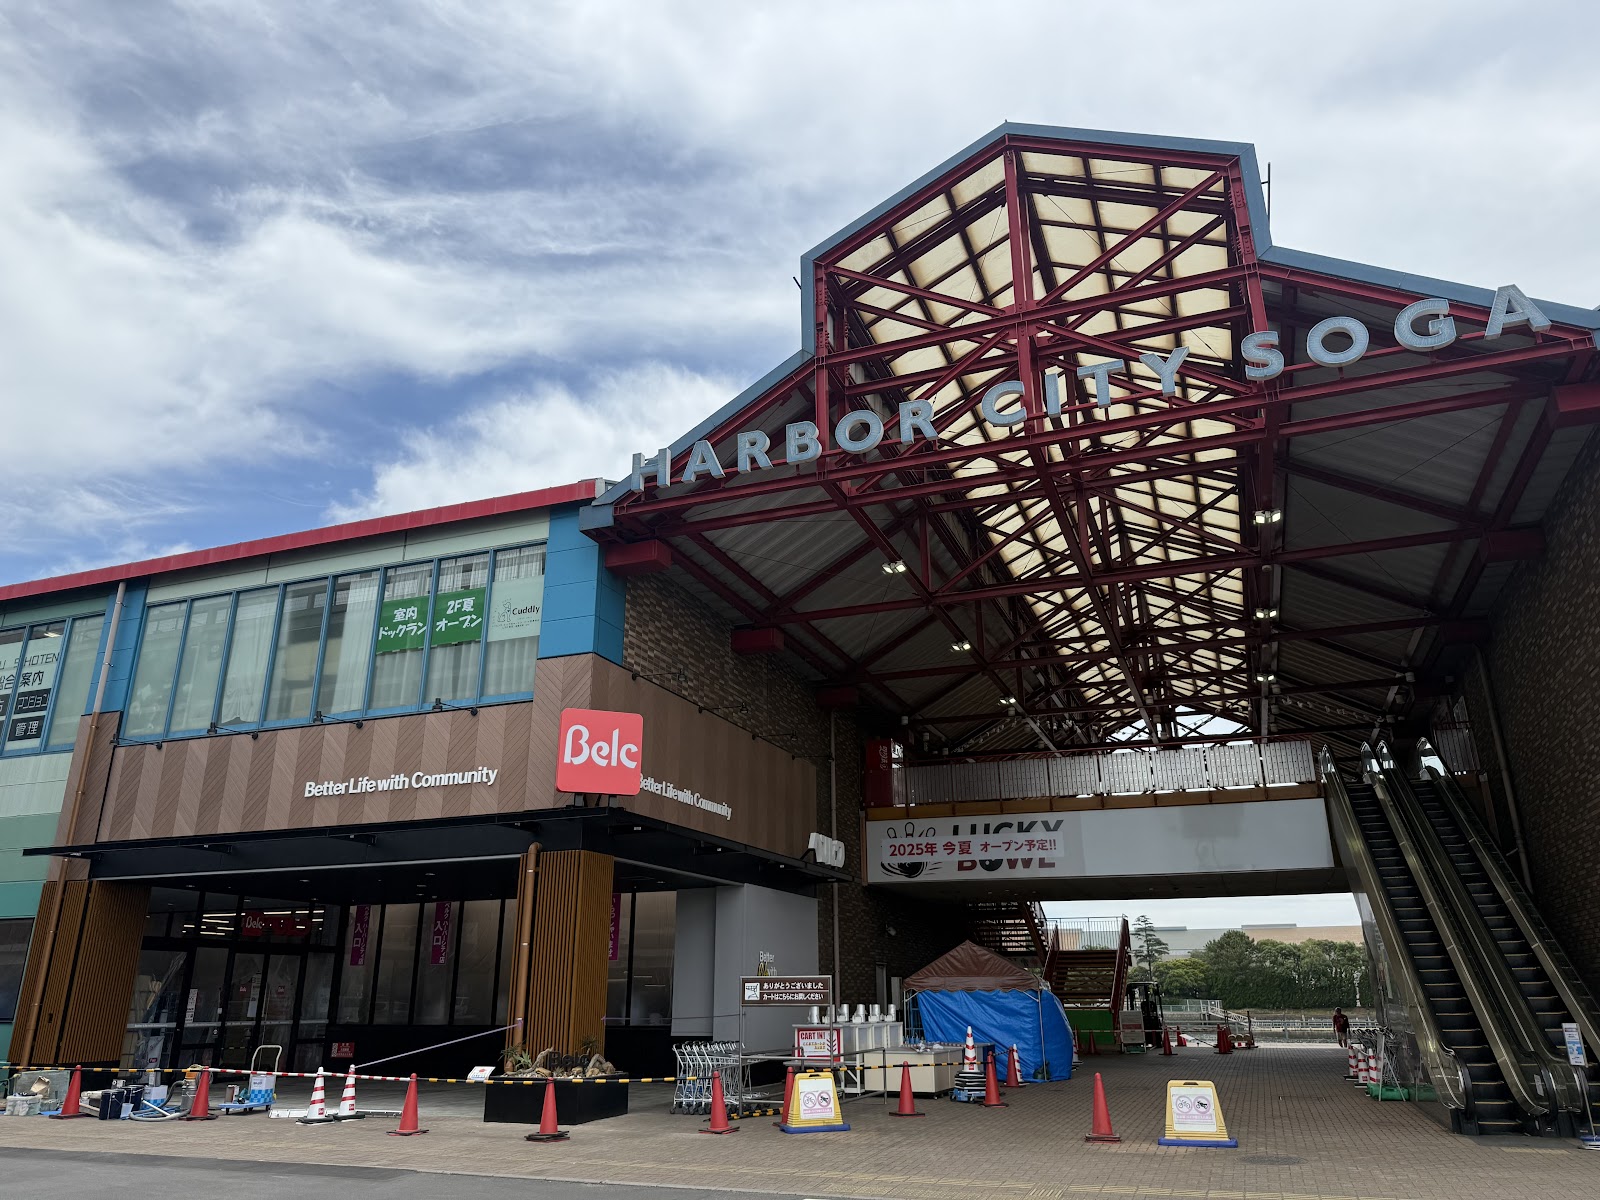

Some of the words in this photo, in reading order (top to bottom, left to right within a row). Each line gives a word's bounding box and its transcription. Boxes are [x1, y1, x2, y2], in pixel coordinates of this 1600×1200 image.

[631, 399, 938, 493] HARBOR
[981, 346, 1189, 426] CITY
[1241, 284, 1552, 381] SOGA
[393, 606, 418, 622] 室内
[446, 597, 476, 615] 2F夏
[512, 605, 541, 616] Cuddly
[436, 614, 482, 632] オープン
[15, 721, 39, 737] 管理
[563, 724, 639, 769] Belc
[304, 780, 348, 798] Better
[349, 776, 376, 794] Life
[378, 773, 409, 792] with
[411, 766, 498, 788] Community
[662, 781, 678, 800] Life
[677, 788, 694, 806] with
[694, 793, 732, 820] Community
[889, 841, 938, 857] 2025年
[942, 840, 972, 855] 今夏
[980, 839, 1056, 852] オープン予定!!
[353, 923, 362, 948] 入口
[433, 921, 442, 945] 入口
[763, 982, 824, 990] ありがとうございました
[800, 1032, 815, 1040] CART
